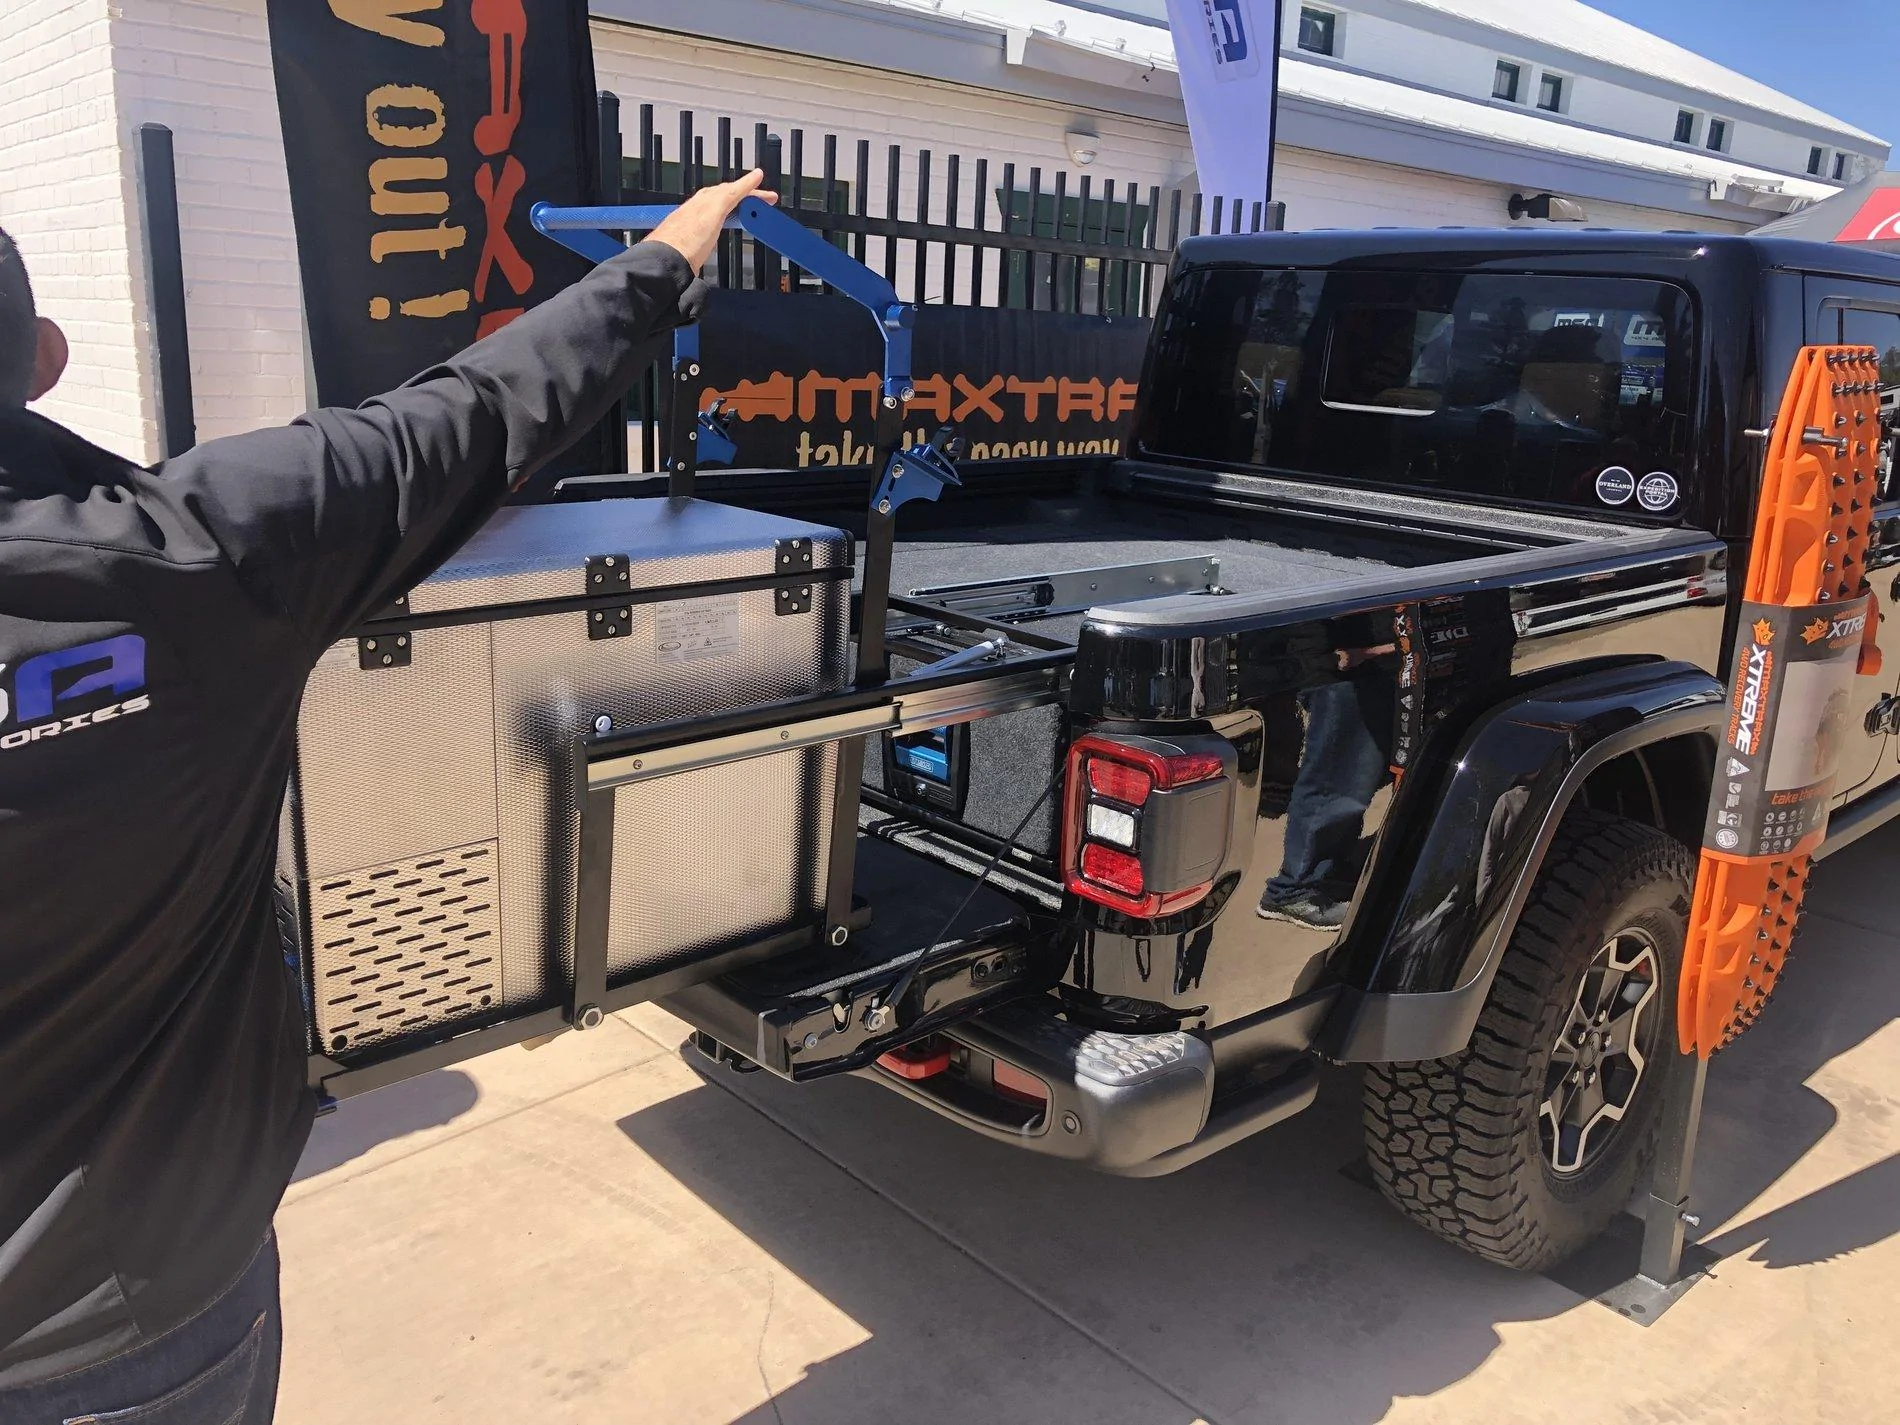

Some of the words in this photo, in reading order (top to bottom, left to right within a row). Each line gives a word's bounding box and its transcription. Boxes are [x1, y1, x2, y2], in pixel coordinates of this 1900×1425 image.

[366, 83, 470, 320] out!
[1598, 481, 1632, 490] OVERLAND
[1740, 646, 1751, 669] 4WD
[1732, 669, 1748, 713] RECOVERY
[1735, 643, 1767, 755] XTREME
[1726, 713, 1740, 745] TRACKS
[1770, 792, 1799, 805] take
